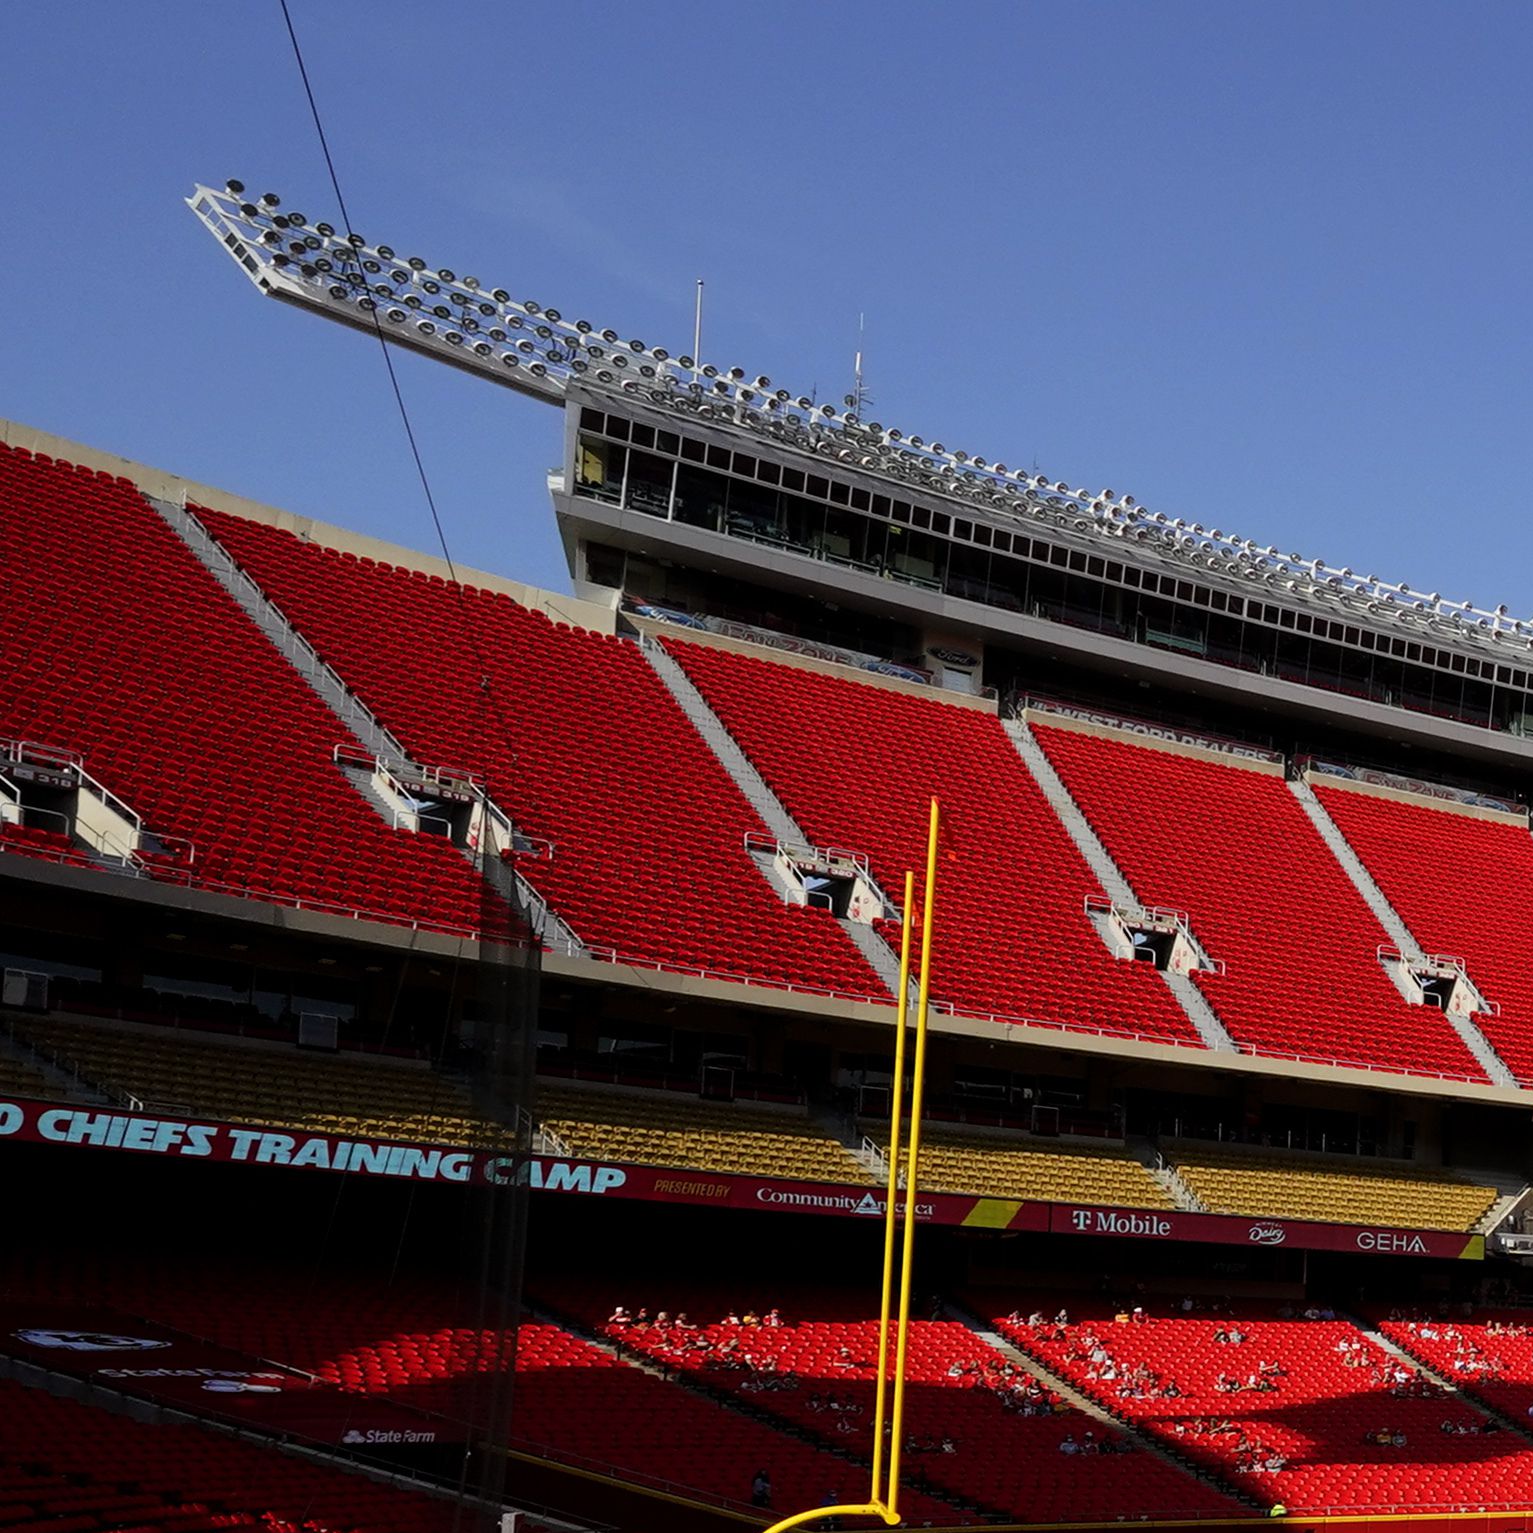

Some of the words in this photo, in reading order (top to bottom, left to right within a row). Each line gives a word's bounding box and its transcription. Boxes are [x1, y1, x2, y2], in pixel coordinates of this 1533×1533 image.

[37, 1109, 218, 1156] CHIEFS
[228, 1129, 475, 1181] TRAINING
[653, 1178, 715, 1196] PRESENTED
[716, 1185, 732, 1198] BY
[1356, 1231, 1427, 1253] GEHA
[366, 1429, 401, 1443] State
[403, 1430, 435, 1443] Farm
